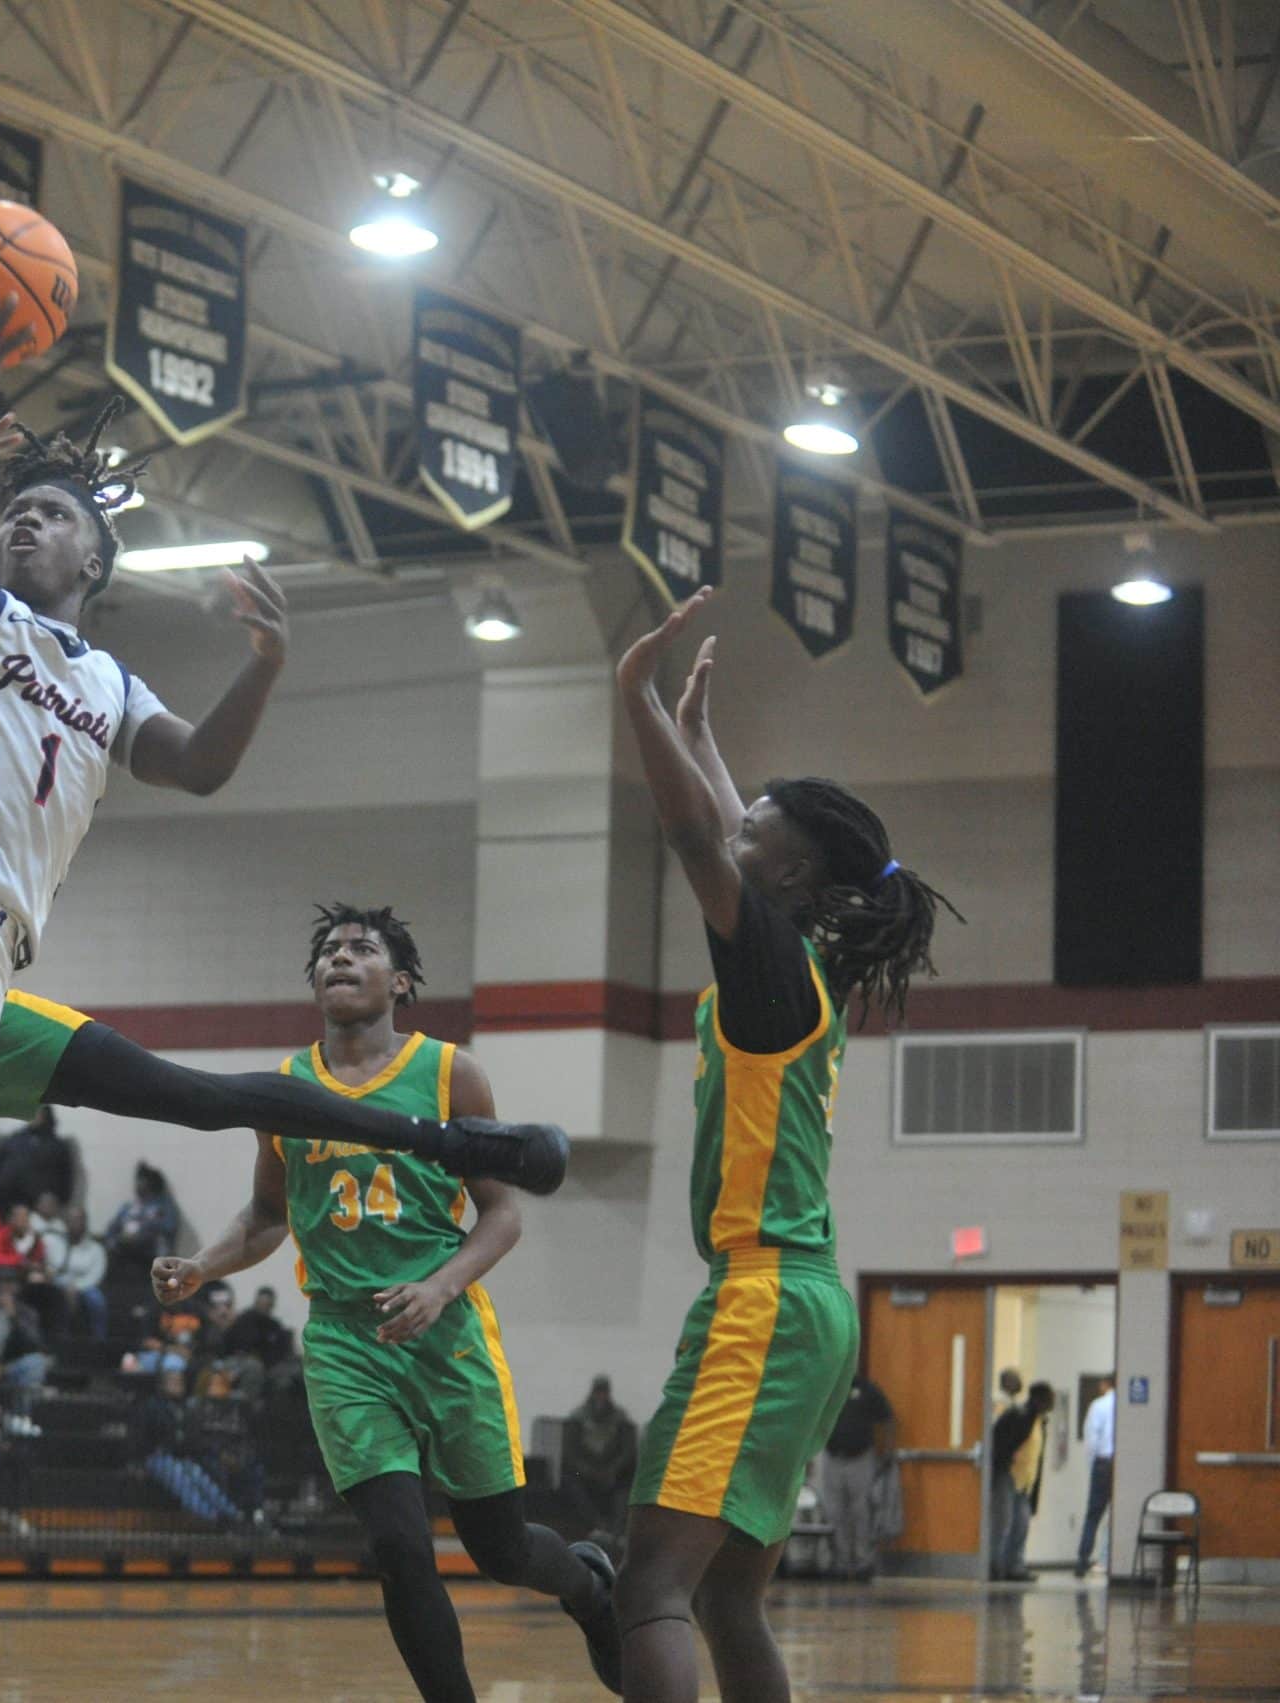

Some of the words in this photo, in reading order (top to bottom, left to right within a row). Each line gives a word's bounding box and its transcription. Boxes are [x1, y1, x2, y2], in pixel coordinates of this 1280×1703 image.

[34, 733, 62, 808] 1
[329, 1163, 403, 1232] 34
[1245, 1238, 1271, 1260] NO
